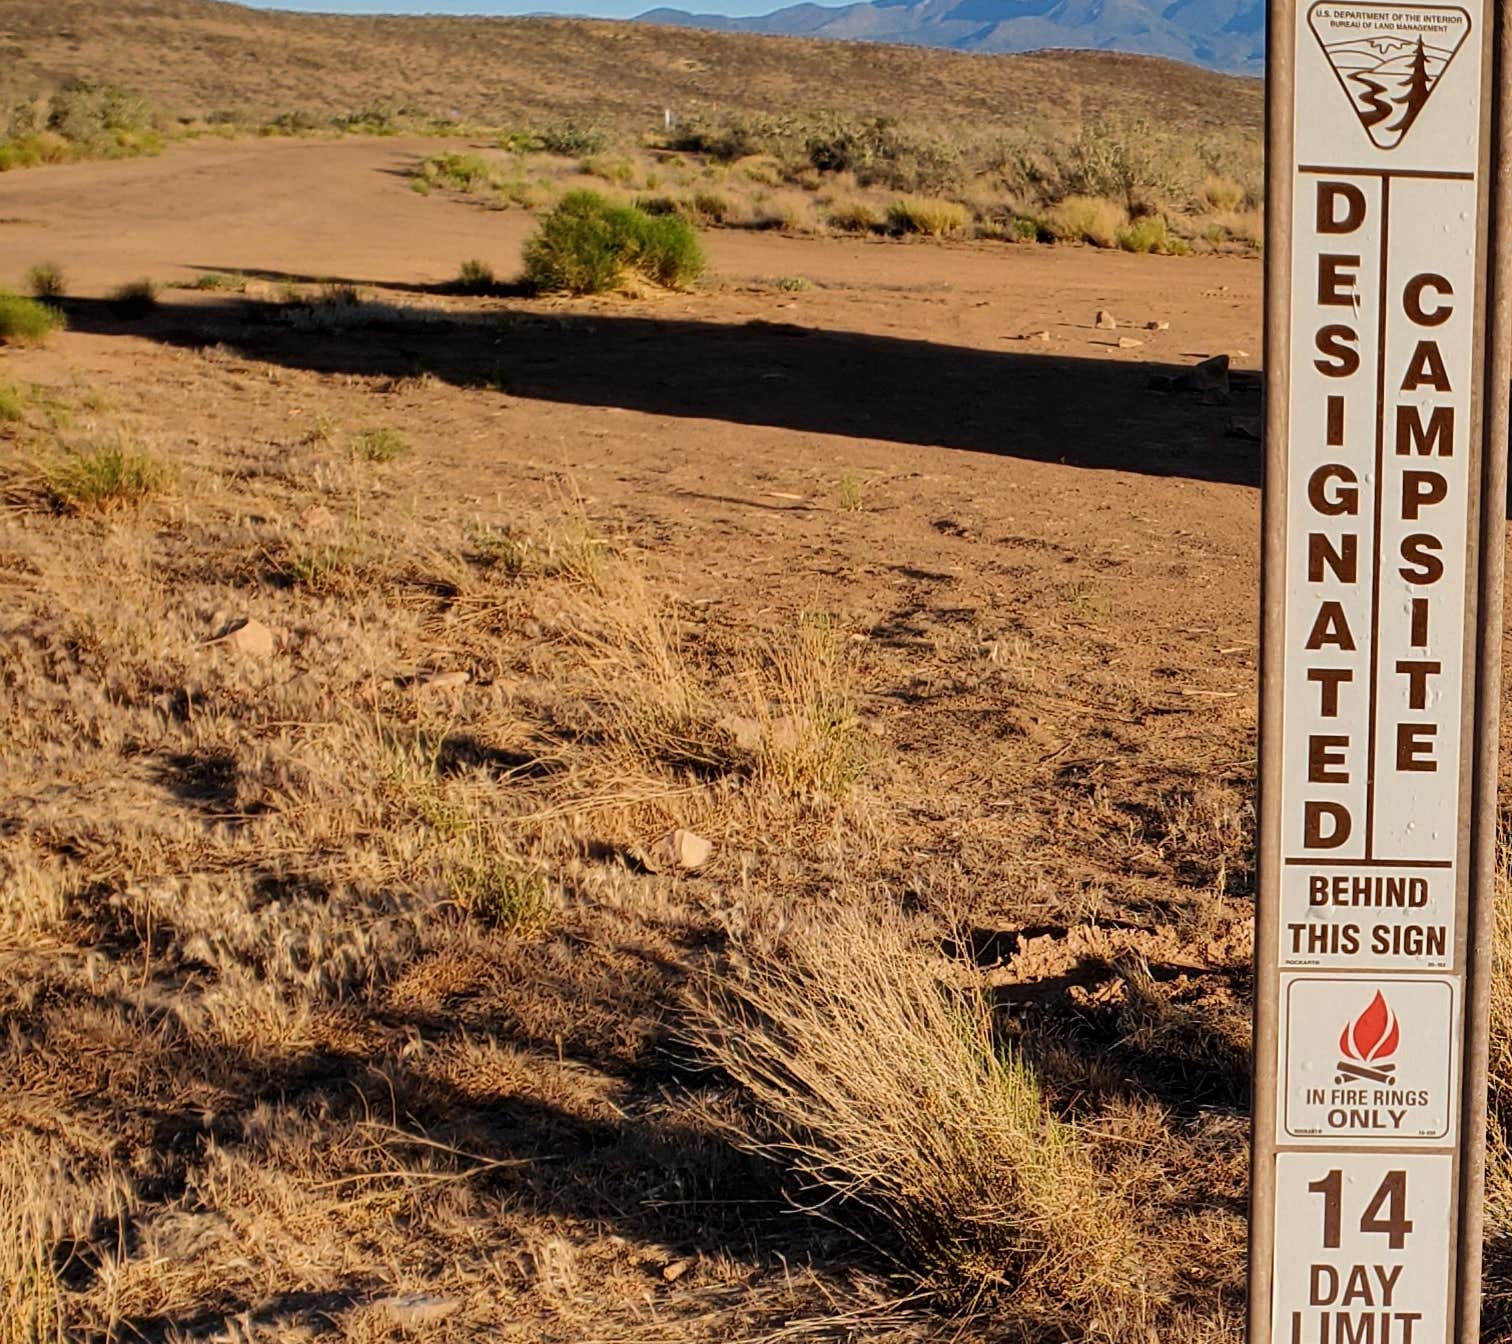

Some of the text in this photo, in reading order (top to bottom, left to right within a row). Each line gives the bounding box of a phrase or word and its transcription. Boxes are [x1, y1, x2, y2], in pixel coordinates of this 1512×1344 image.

[1330, 20, 1449, 33] BUREAU OF LAND MANAGEMENT
[1333, 11, 1390, 21] DEPARTMENT
[1392, 13, 1404, 21] OF
[1405, 13, 1421, 22] THE
[1423, 14, 1463, 24] INTERIOR
[1303, 180, 1367, 849] DESIGNATED
[1395, 272, 1455, 772] CAMPSITE
[1309, 875, 1429, 907] BEHIND
[1287, 923, 1446, 956] THIS SIGN
[1306, 1089, 1429, 1106] IN FIRE RINGS
[1327, 1109, 1408, 1129] ONLY
[1308, 1169, 1413, 1249] 14
[1309, 1264, 1404, 1306] DAY
